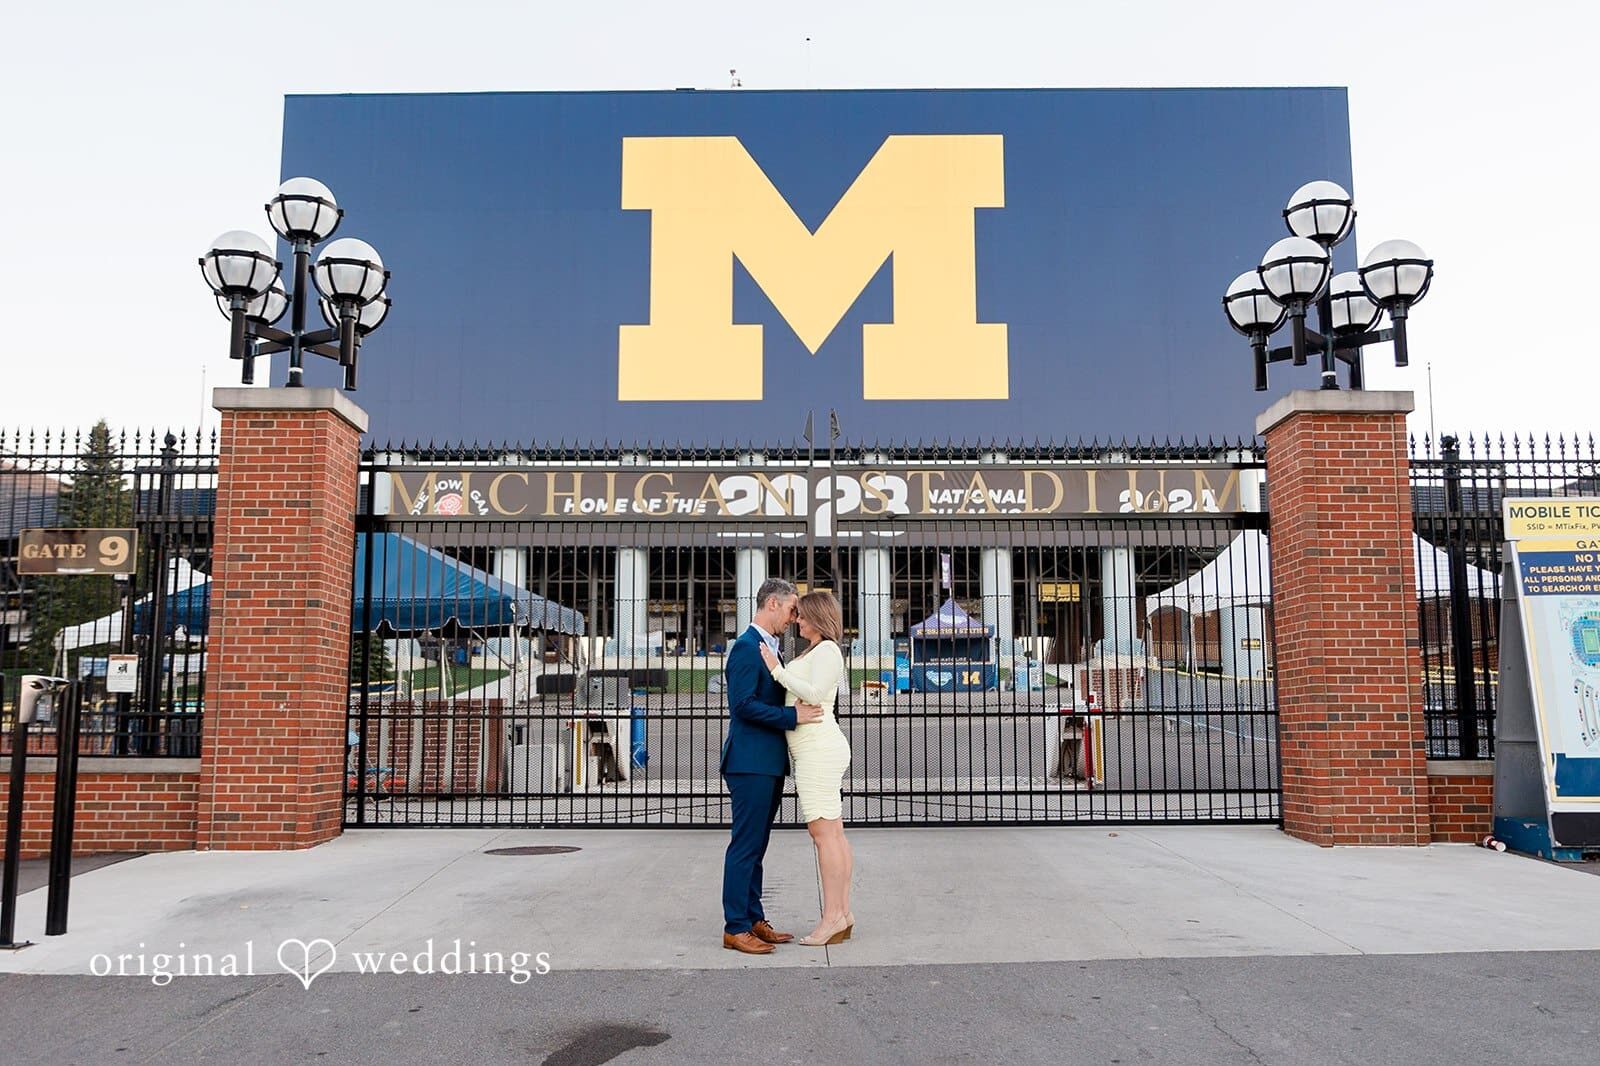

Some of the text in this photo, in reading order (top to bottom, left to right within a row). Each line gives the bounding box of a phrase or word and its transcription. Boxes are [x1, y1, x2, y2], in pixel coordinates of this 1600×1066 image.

[618, 134, 1009, 401] M
[389, 469, 1243, 516] MICHIGAN STADIUM
[928, 488, 1027, 504] NATIONAL
[563, 497, 629, 514] HOME
[632, 497, 661, 514] OF
[1509, 506, 1571, 519] MOBILE
[22, 535, 130, 567] GATE 9
[1575, 540, 1600, 550] GA
[1574, 554, 1594, 564] NO
[1529, 566, 1566, 574] PLEASE
[1568, 565, 1593, 573] HAVE
[1523, 576, 1540, 584] ALL
[1541, 575, 1583, 583] PERSONS
[1528, 585, 1540, 593] TO
[1542, 585, 1577, 593] SEARCH
[1578, 584, 1592, 592] OR
